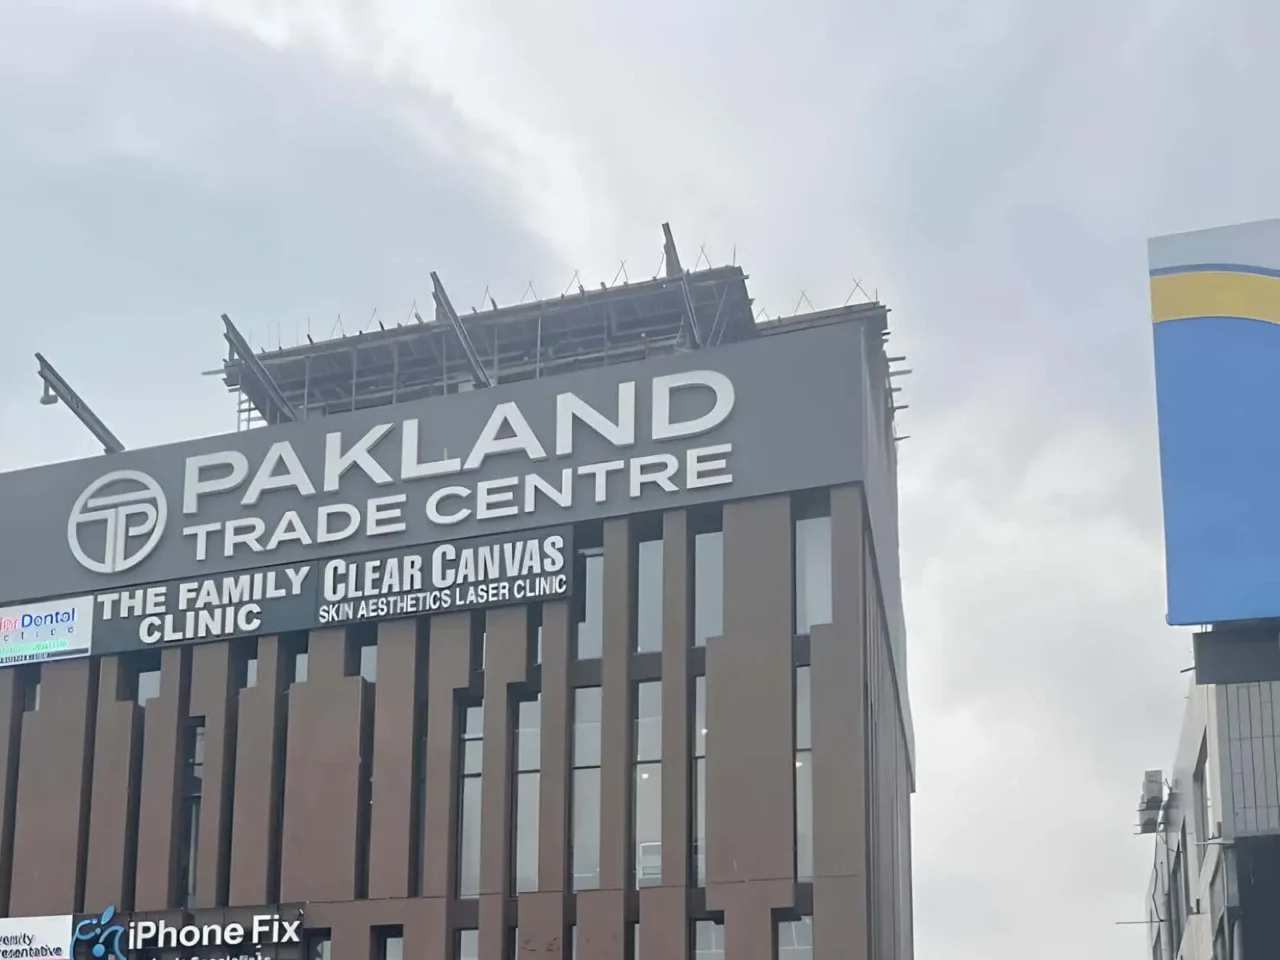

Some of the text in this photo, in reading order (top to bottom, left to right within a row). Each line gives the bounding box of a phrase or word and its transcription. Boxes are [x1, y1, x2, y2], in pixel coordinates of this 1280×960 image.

[183, 368, 735, 516] PAKLAND
[182, 443, 733, 562] TRADE CENTRE
[97, 565, 311, 621] THE FAMILY
[323, 534, 565, 602] CLEAR CANVAS
[138, 602, 262, 645] CLINIC
[318, 574, 568, 625] SKIN AESTHETICS LASER CLINIC
[128, 914, 301, 950] iPhone Fix
